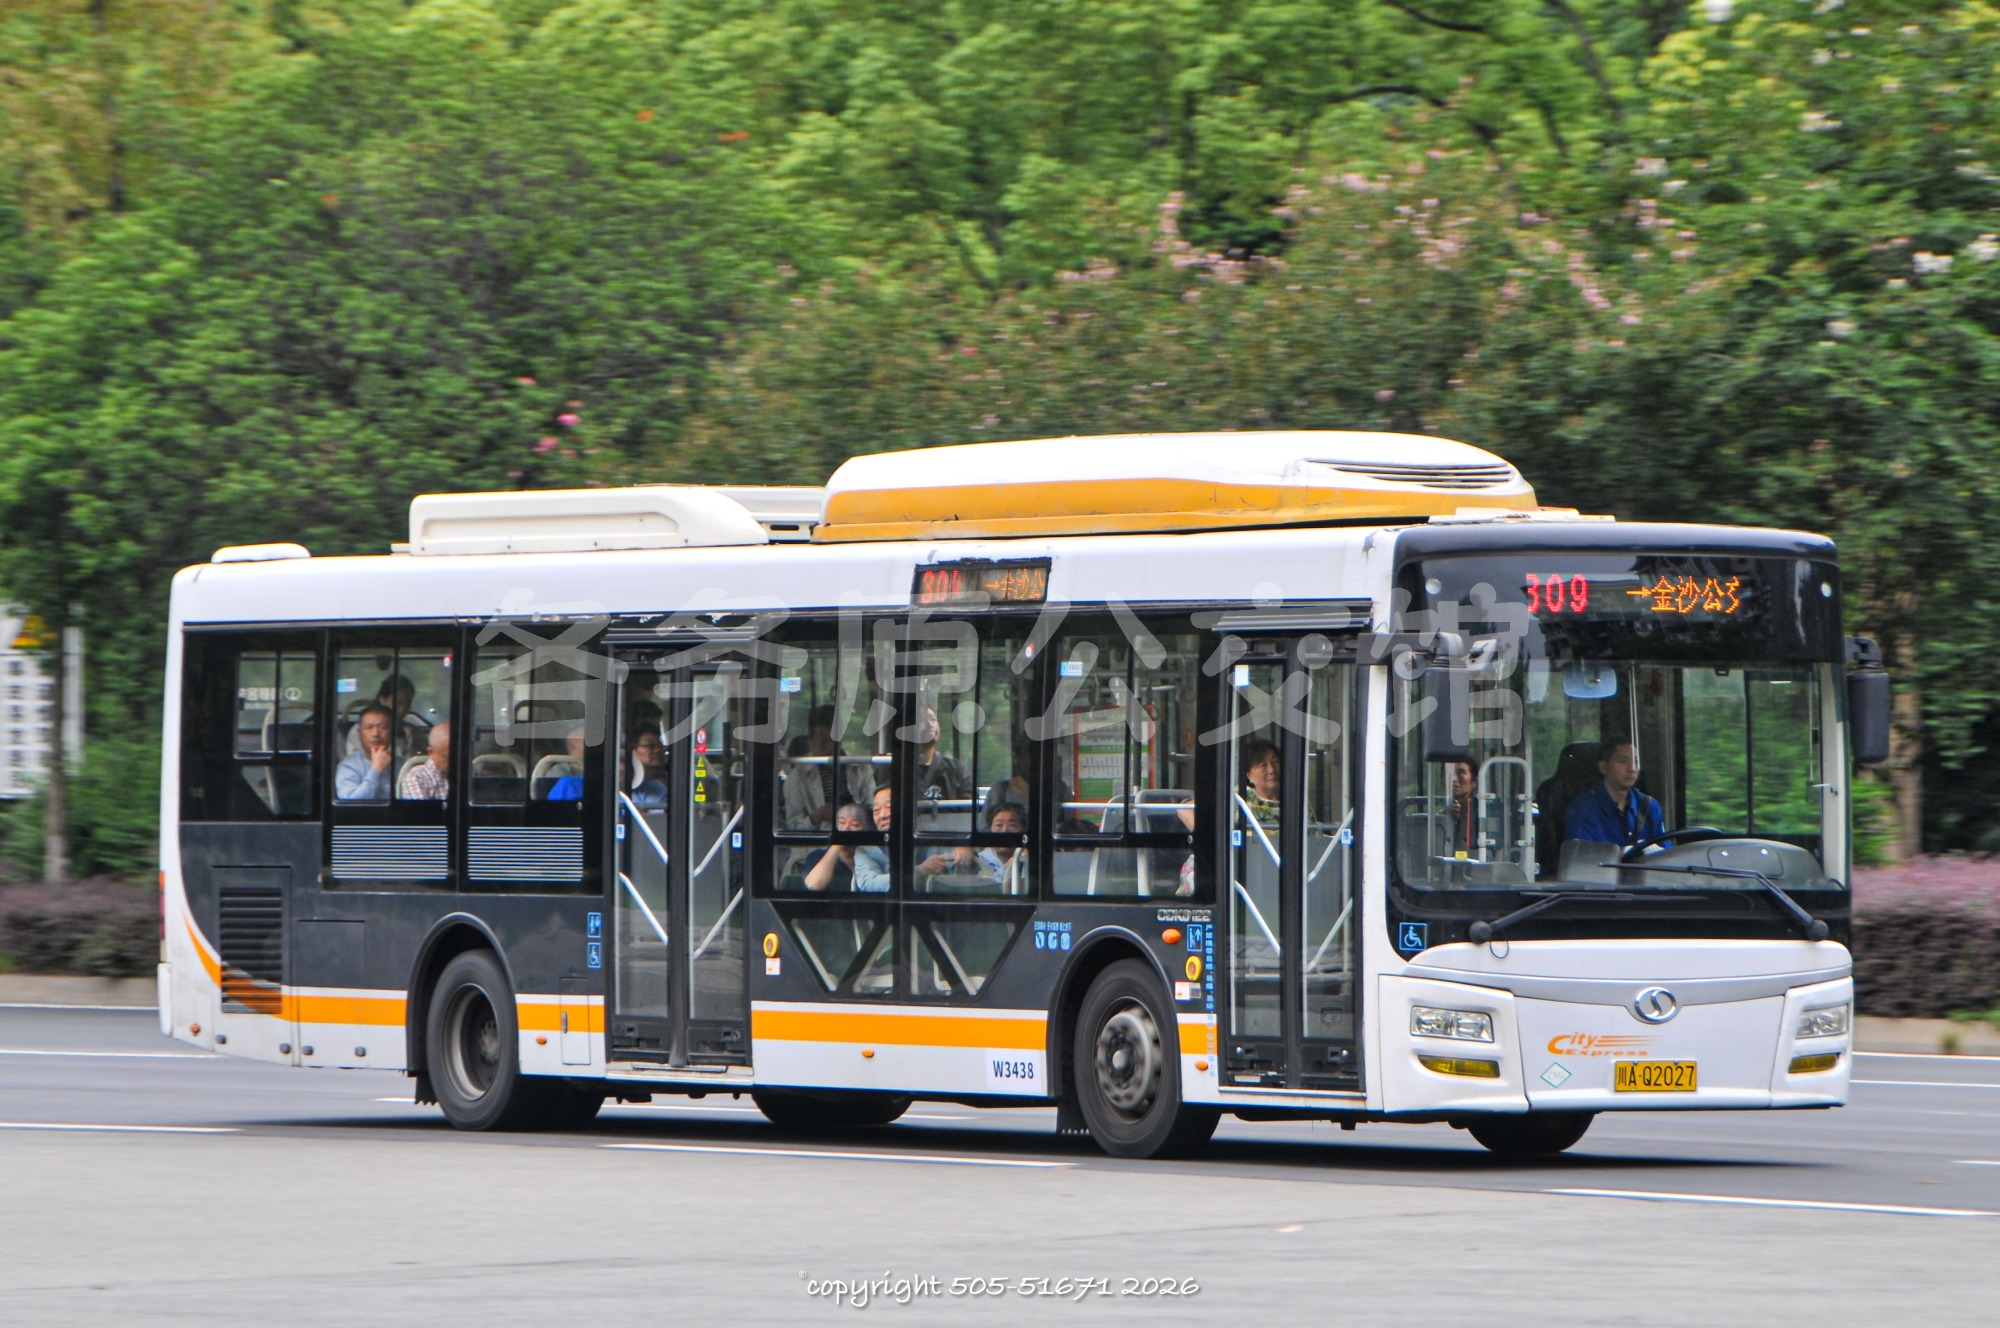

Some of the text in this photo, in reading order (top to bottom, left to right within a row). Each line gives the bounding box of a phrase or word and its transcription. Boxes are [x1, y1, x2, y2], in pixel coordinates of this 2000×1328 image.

[1526, 573, 1588, 612] 309
[1547, 1031, 1599, 1055] City
[1564, 1048, 1648, 1057] Express
[993, 1060, 1034, 1079] W3438
